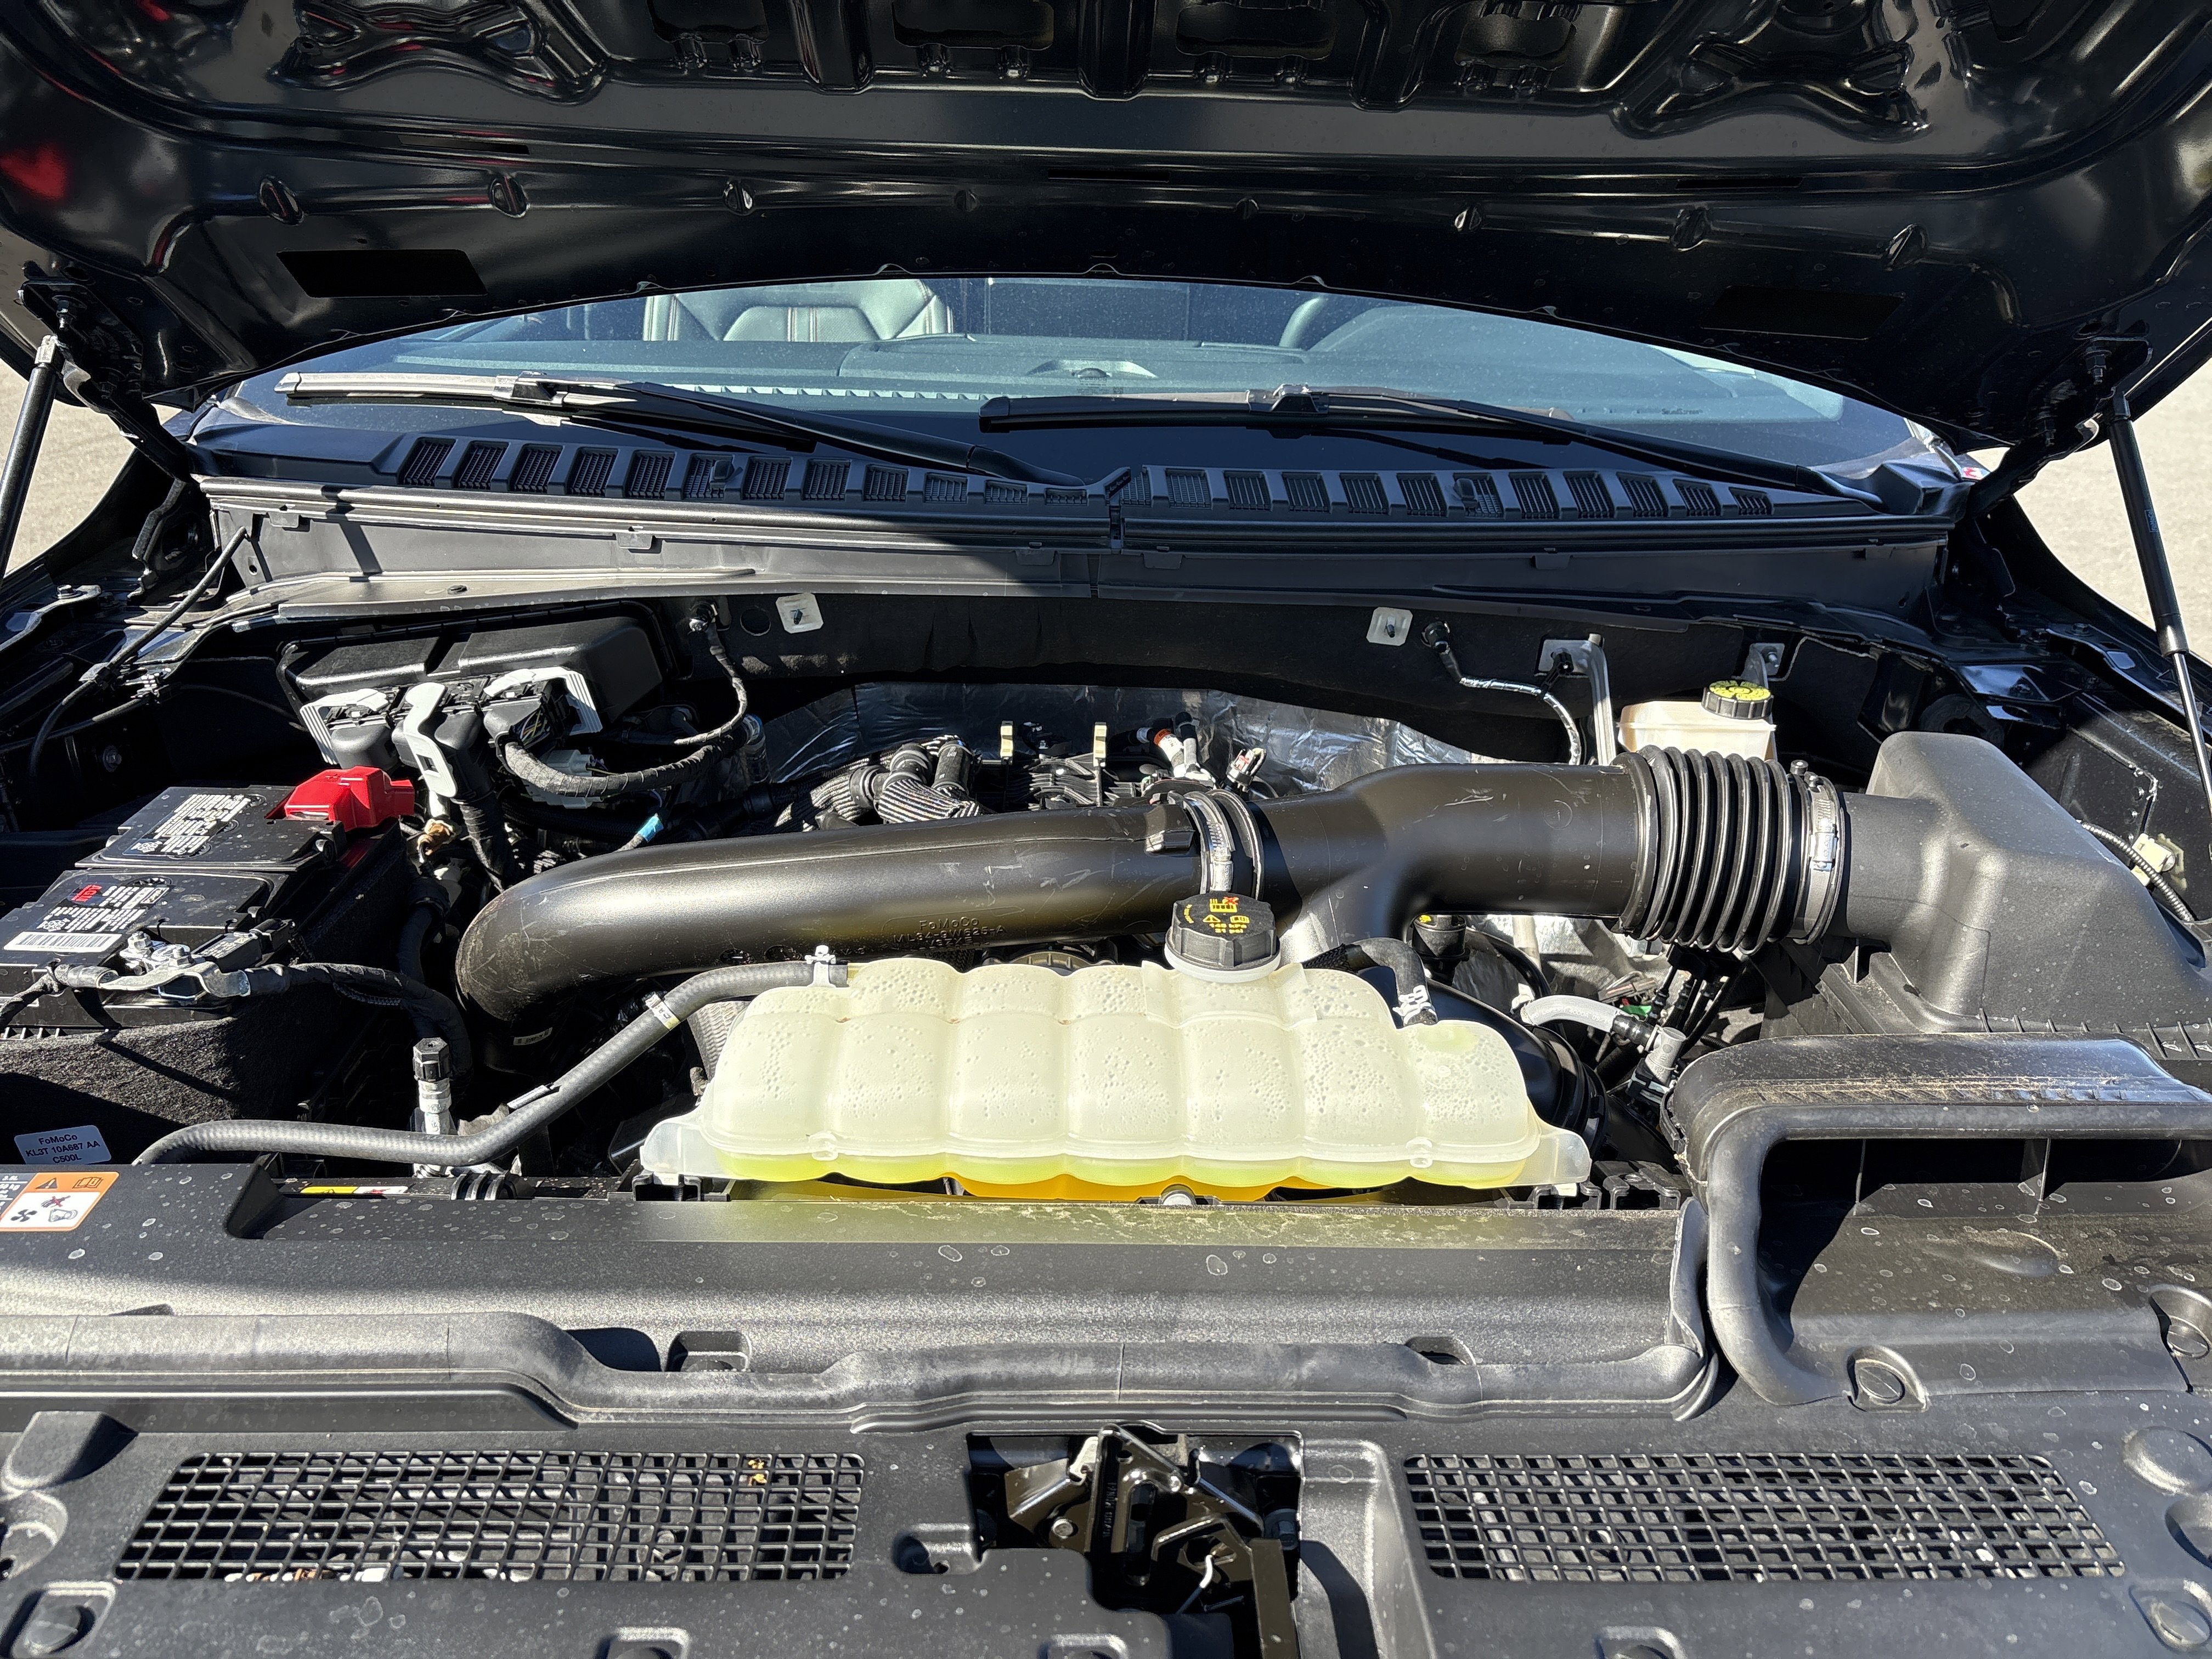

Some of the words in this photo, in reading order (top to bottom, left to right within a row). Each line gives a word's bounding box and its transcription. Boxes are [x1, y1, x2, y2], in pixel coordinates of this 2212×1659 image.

[919, 916, 979, 930] FoMoCo
[38, 1134, 78, 1145] FoMoCo
[26, 1147, 49, 1157] KL3T
[51, 1143, 83, 1154] 10A687
[52, 1154, 82, 1164] C500L
